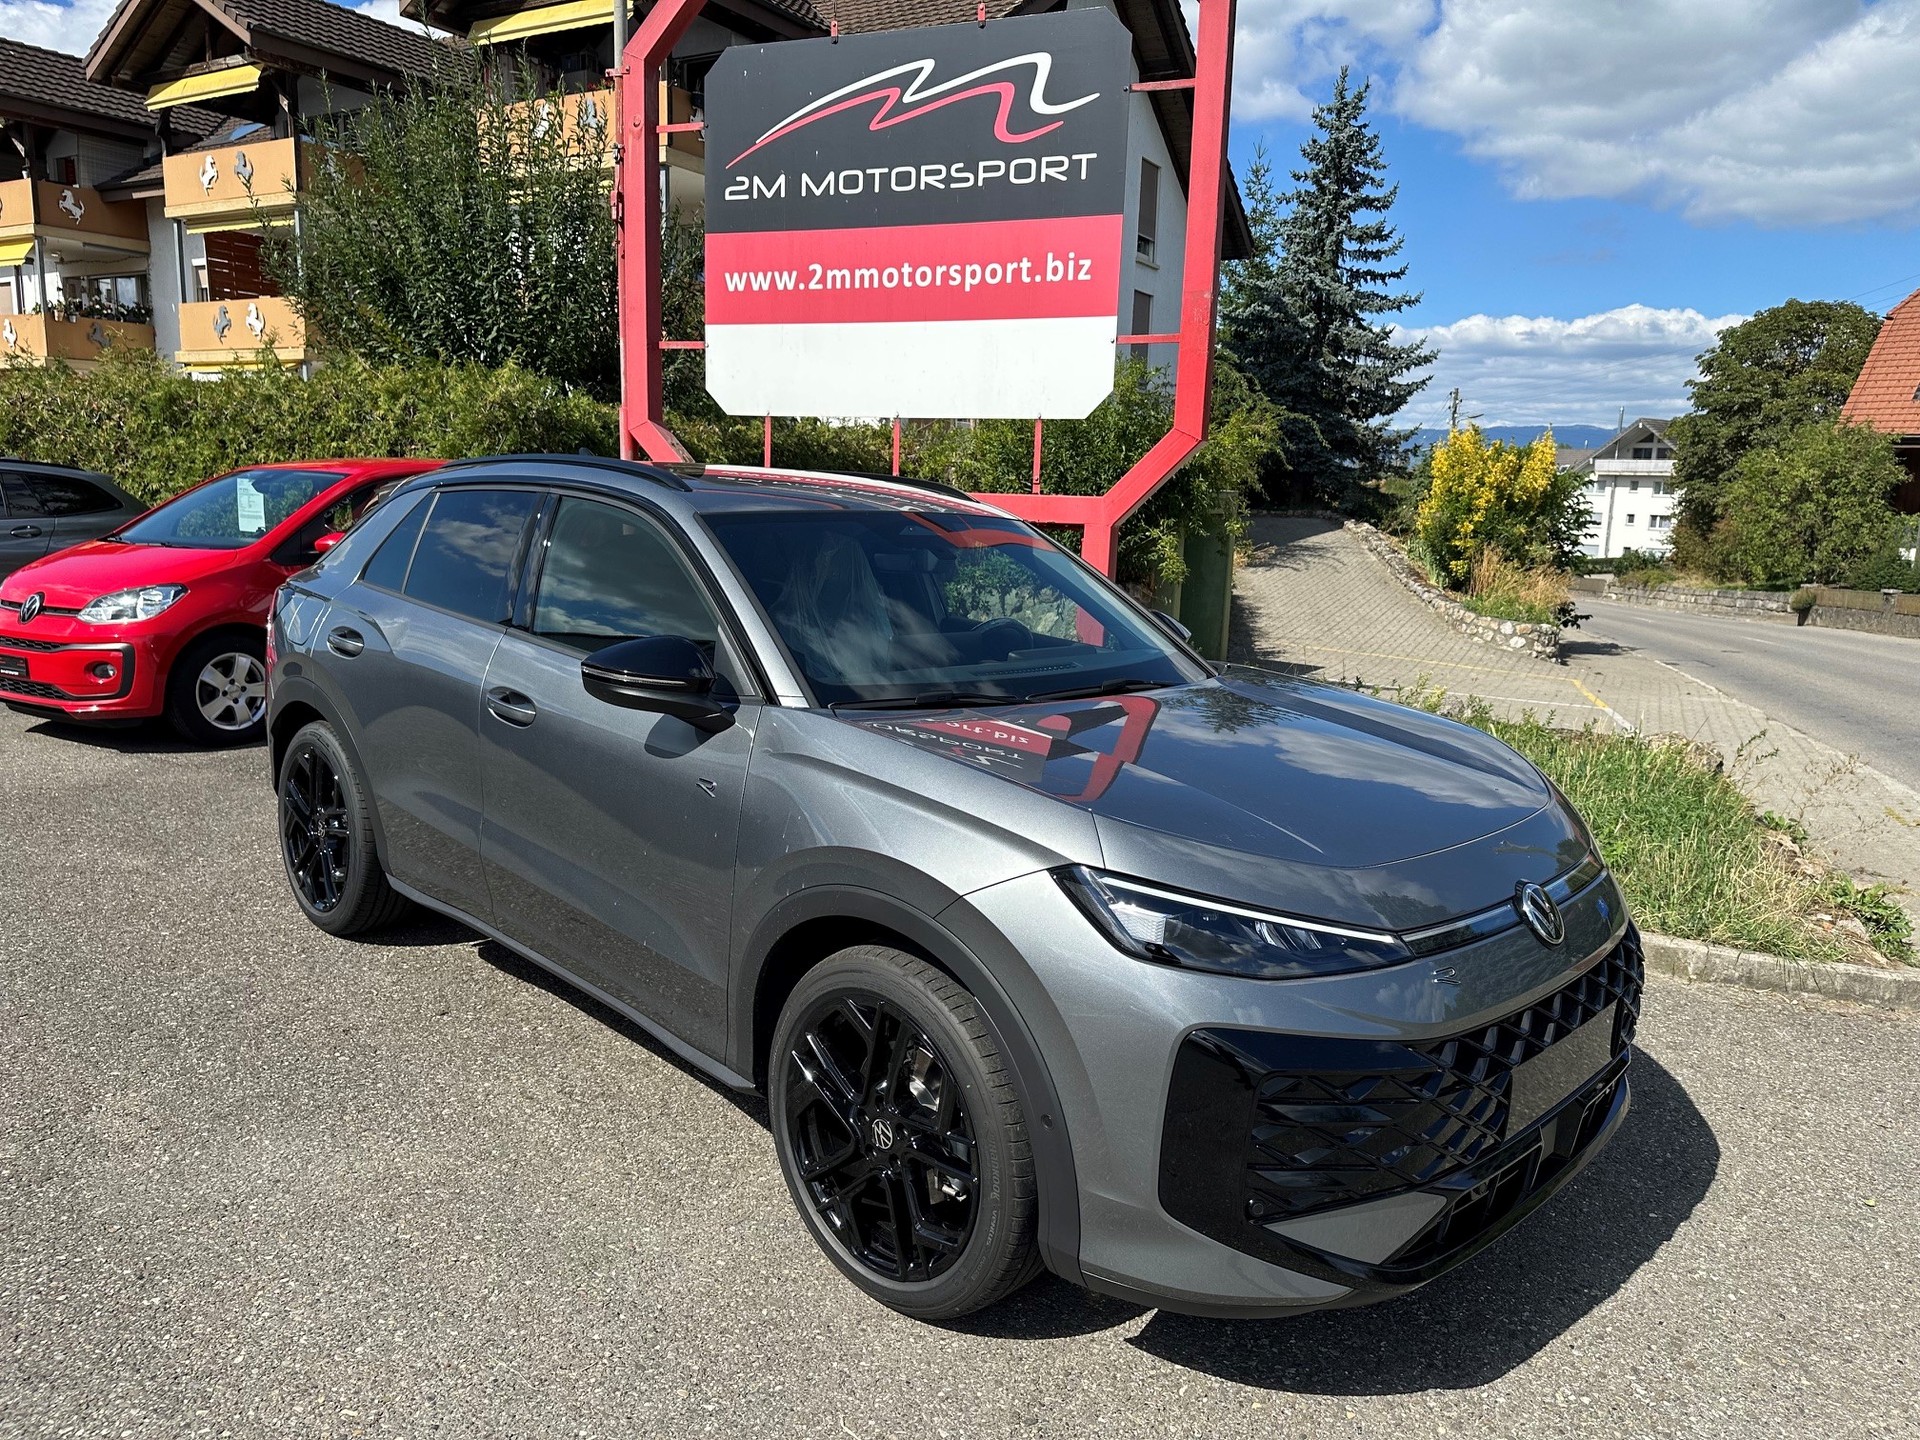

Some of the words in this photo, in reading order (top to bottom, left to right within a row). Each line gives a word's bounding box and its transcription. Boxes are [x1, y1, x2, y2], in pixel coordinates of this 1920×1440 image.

[725, 174, 786, 201] 2M
[801, 152, 1098, 197] MOTORSPORT
[724, 252, 1092, 292] www.2mmotorsport.biz
